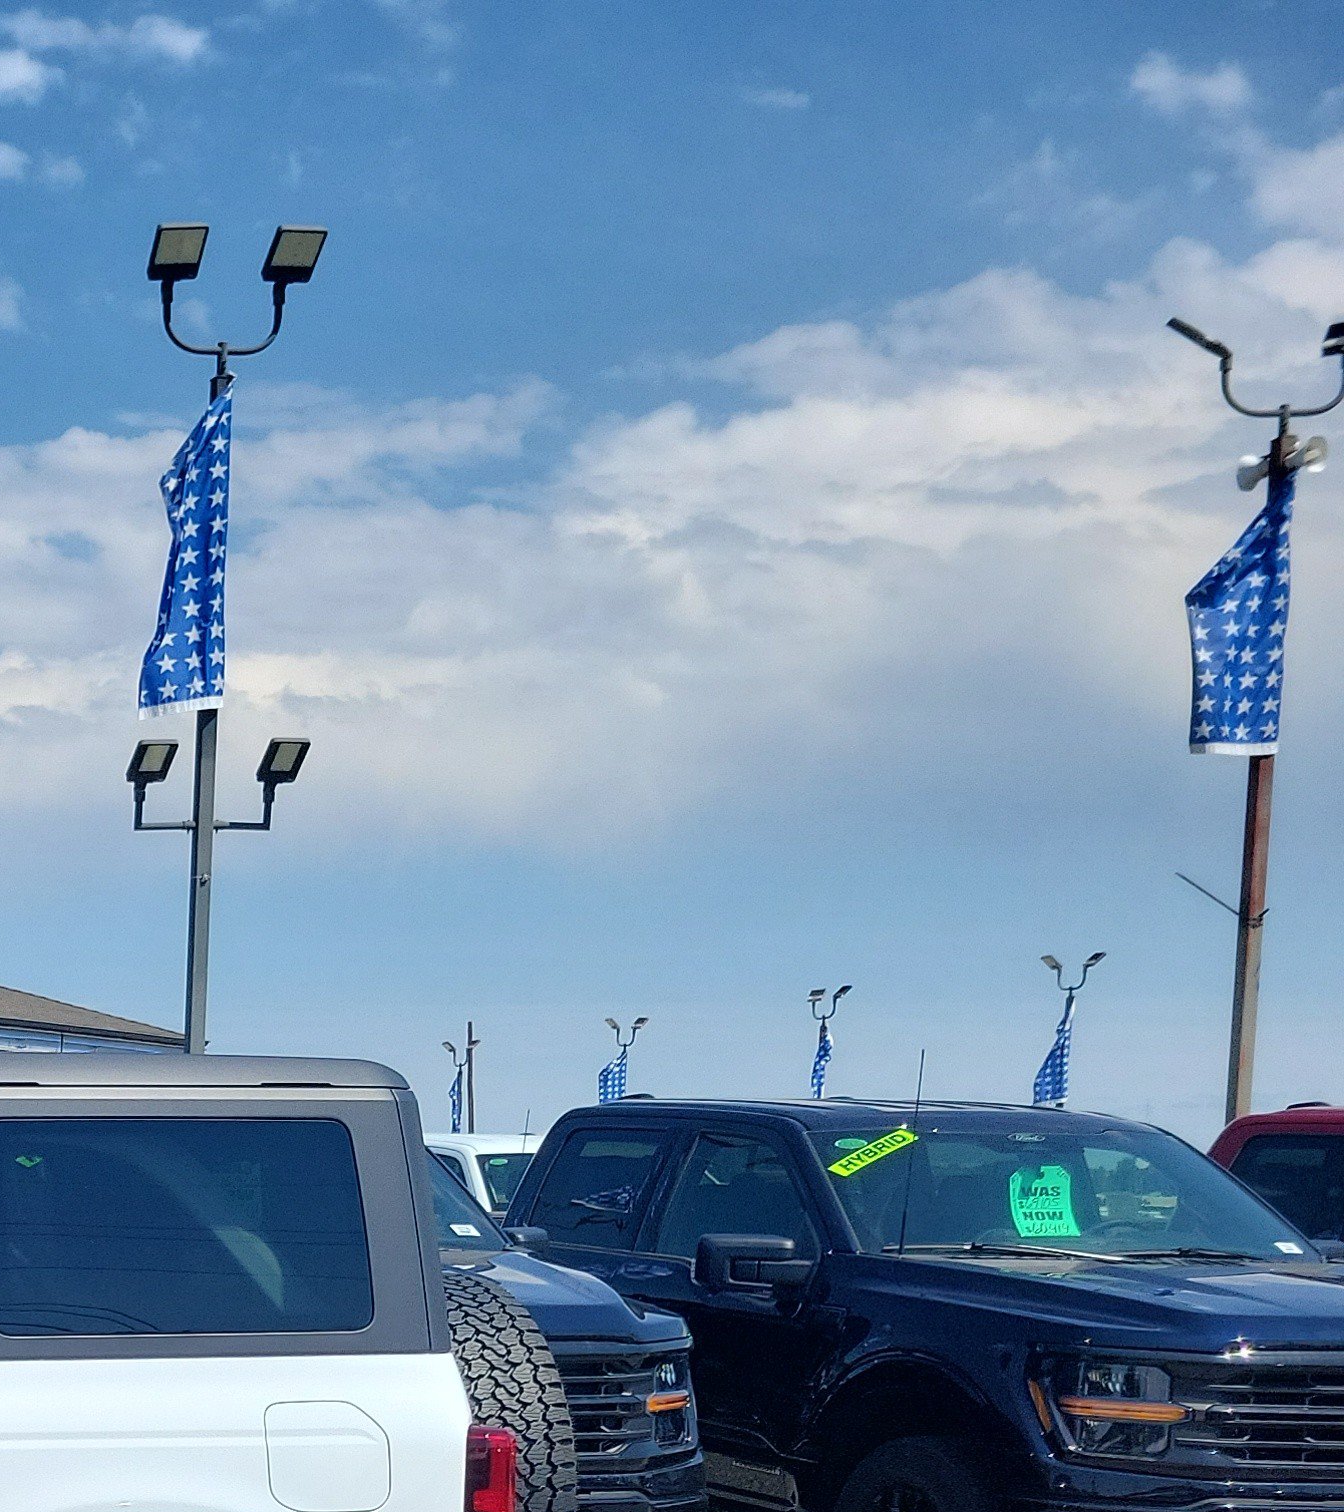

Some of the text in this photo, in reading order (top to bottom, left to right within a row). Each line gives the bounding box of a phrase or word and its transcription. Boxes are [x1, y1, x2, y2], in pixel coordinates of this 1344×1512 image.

[838, 1132, 908, 1173] HYBRID
[1020, 1186, 1061, 1198] WAS
[1021, 1210, 1064, 1221] NOW
